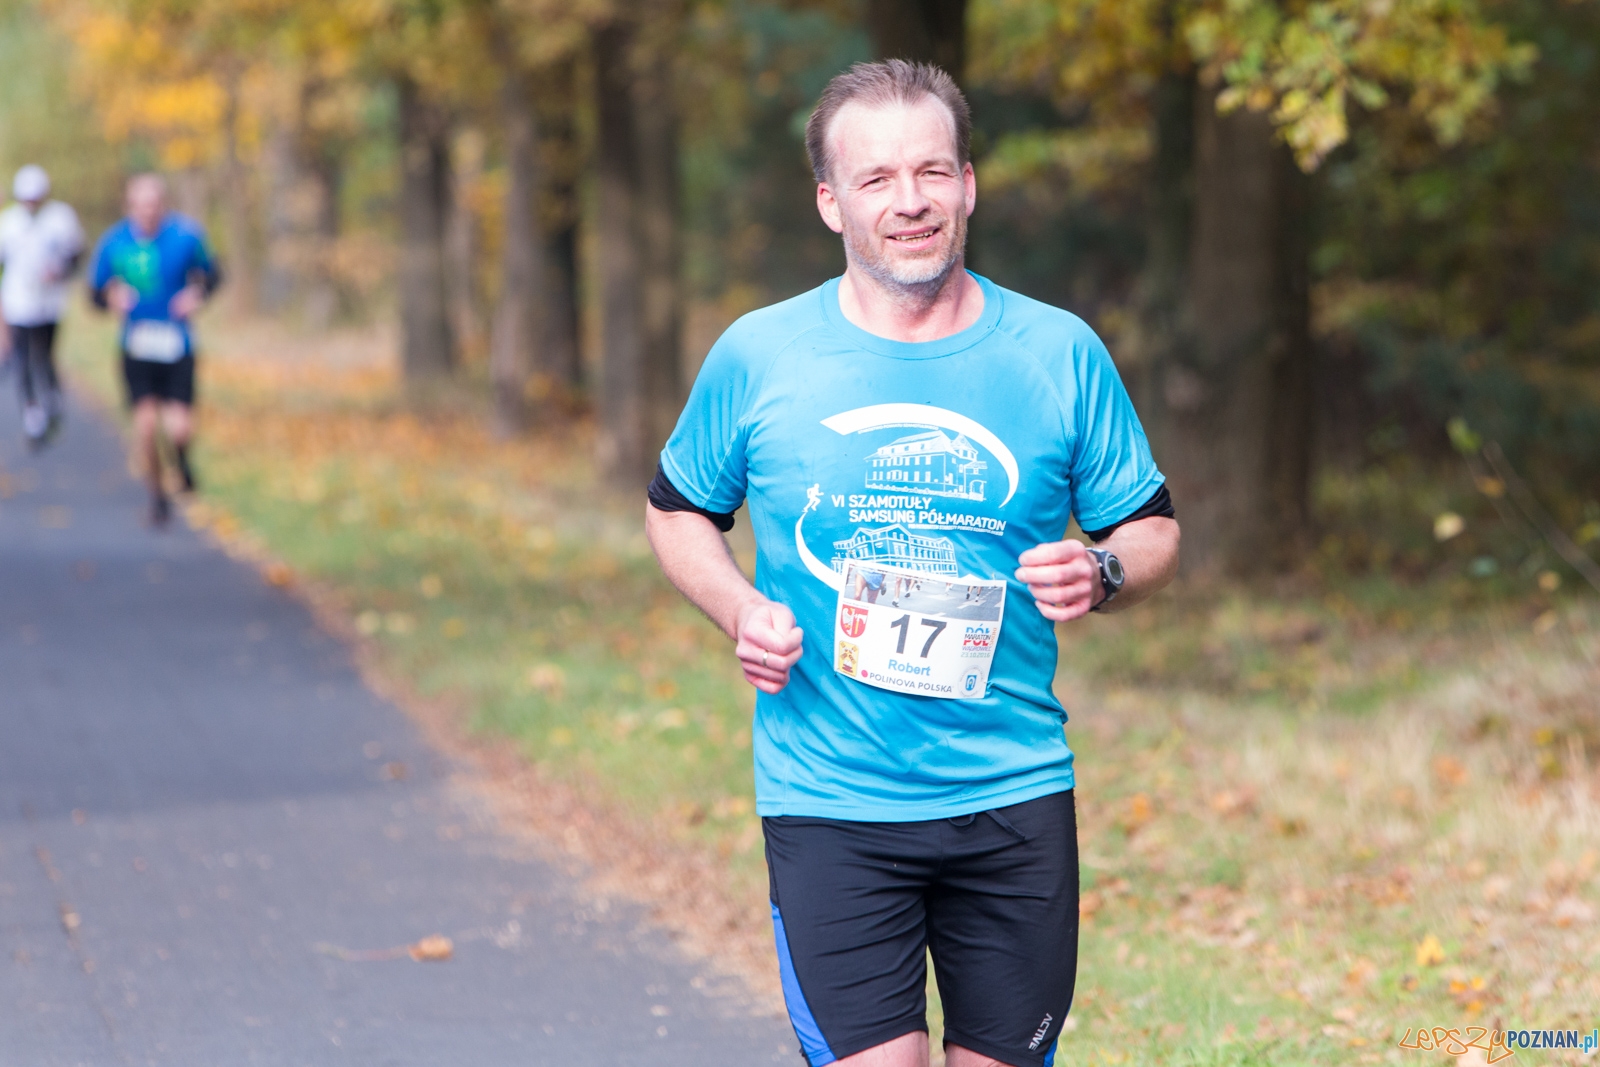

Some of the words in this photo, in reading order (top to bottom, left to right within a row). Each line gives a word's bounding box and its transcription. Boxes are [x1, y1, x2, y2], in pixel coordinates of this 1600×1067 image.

[832, 495, 845, 508] VI
[849, 495, 932, 509] SZAMOTUŁY
[849, 510, 916, 523] SAMSUNG
[919, 509, 1007, 531] PÓŁMARATON
[890, 614, 948, 658] 17
[964, 633, 991, 641] MARATON
[888, 659, 931, 676] Robert
[869, 672, 916, 688] POLINOVA
[917, 682, 952, 693] POLSKA
[1028, 1013, 1053, 1051] ACTIVE
